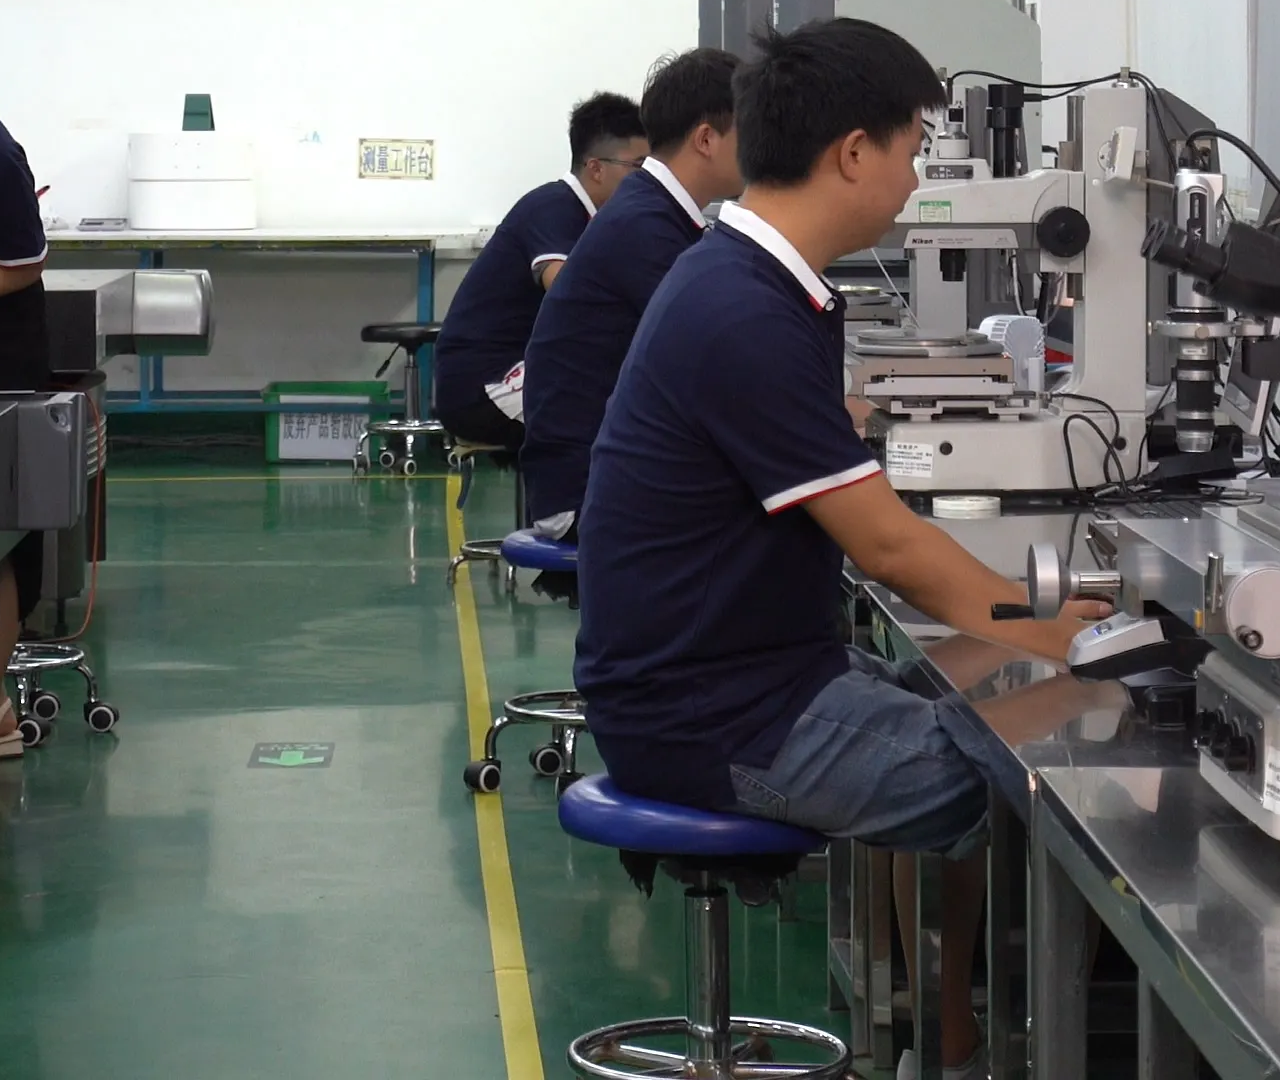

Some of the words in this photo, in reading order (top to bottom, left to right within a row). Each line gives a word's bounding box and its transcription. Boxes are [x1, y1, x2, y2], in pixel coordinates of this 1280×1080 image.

[362, 145, 430, 174] 测量工作台
[911, 237, 934, 245] Nikon
